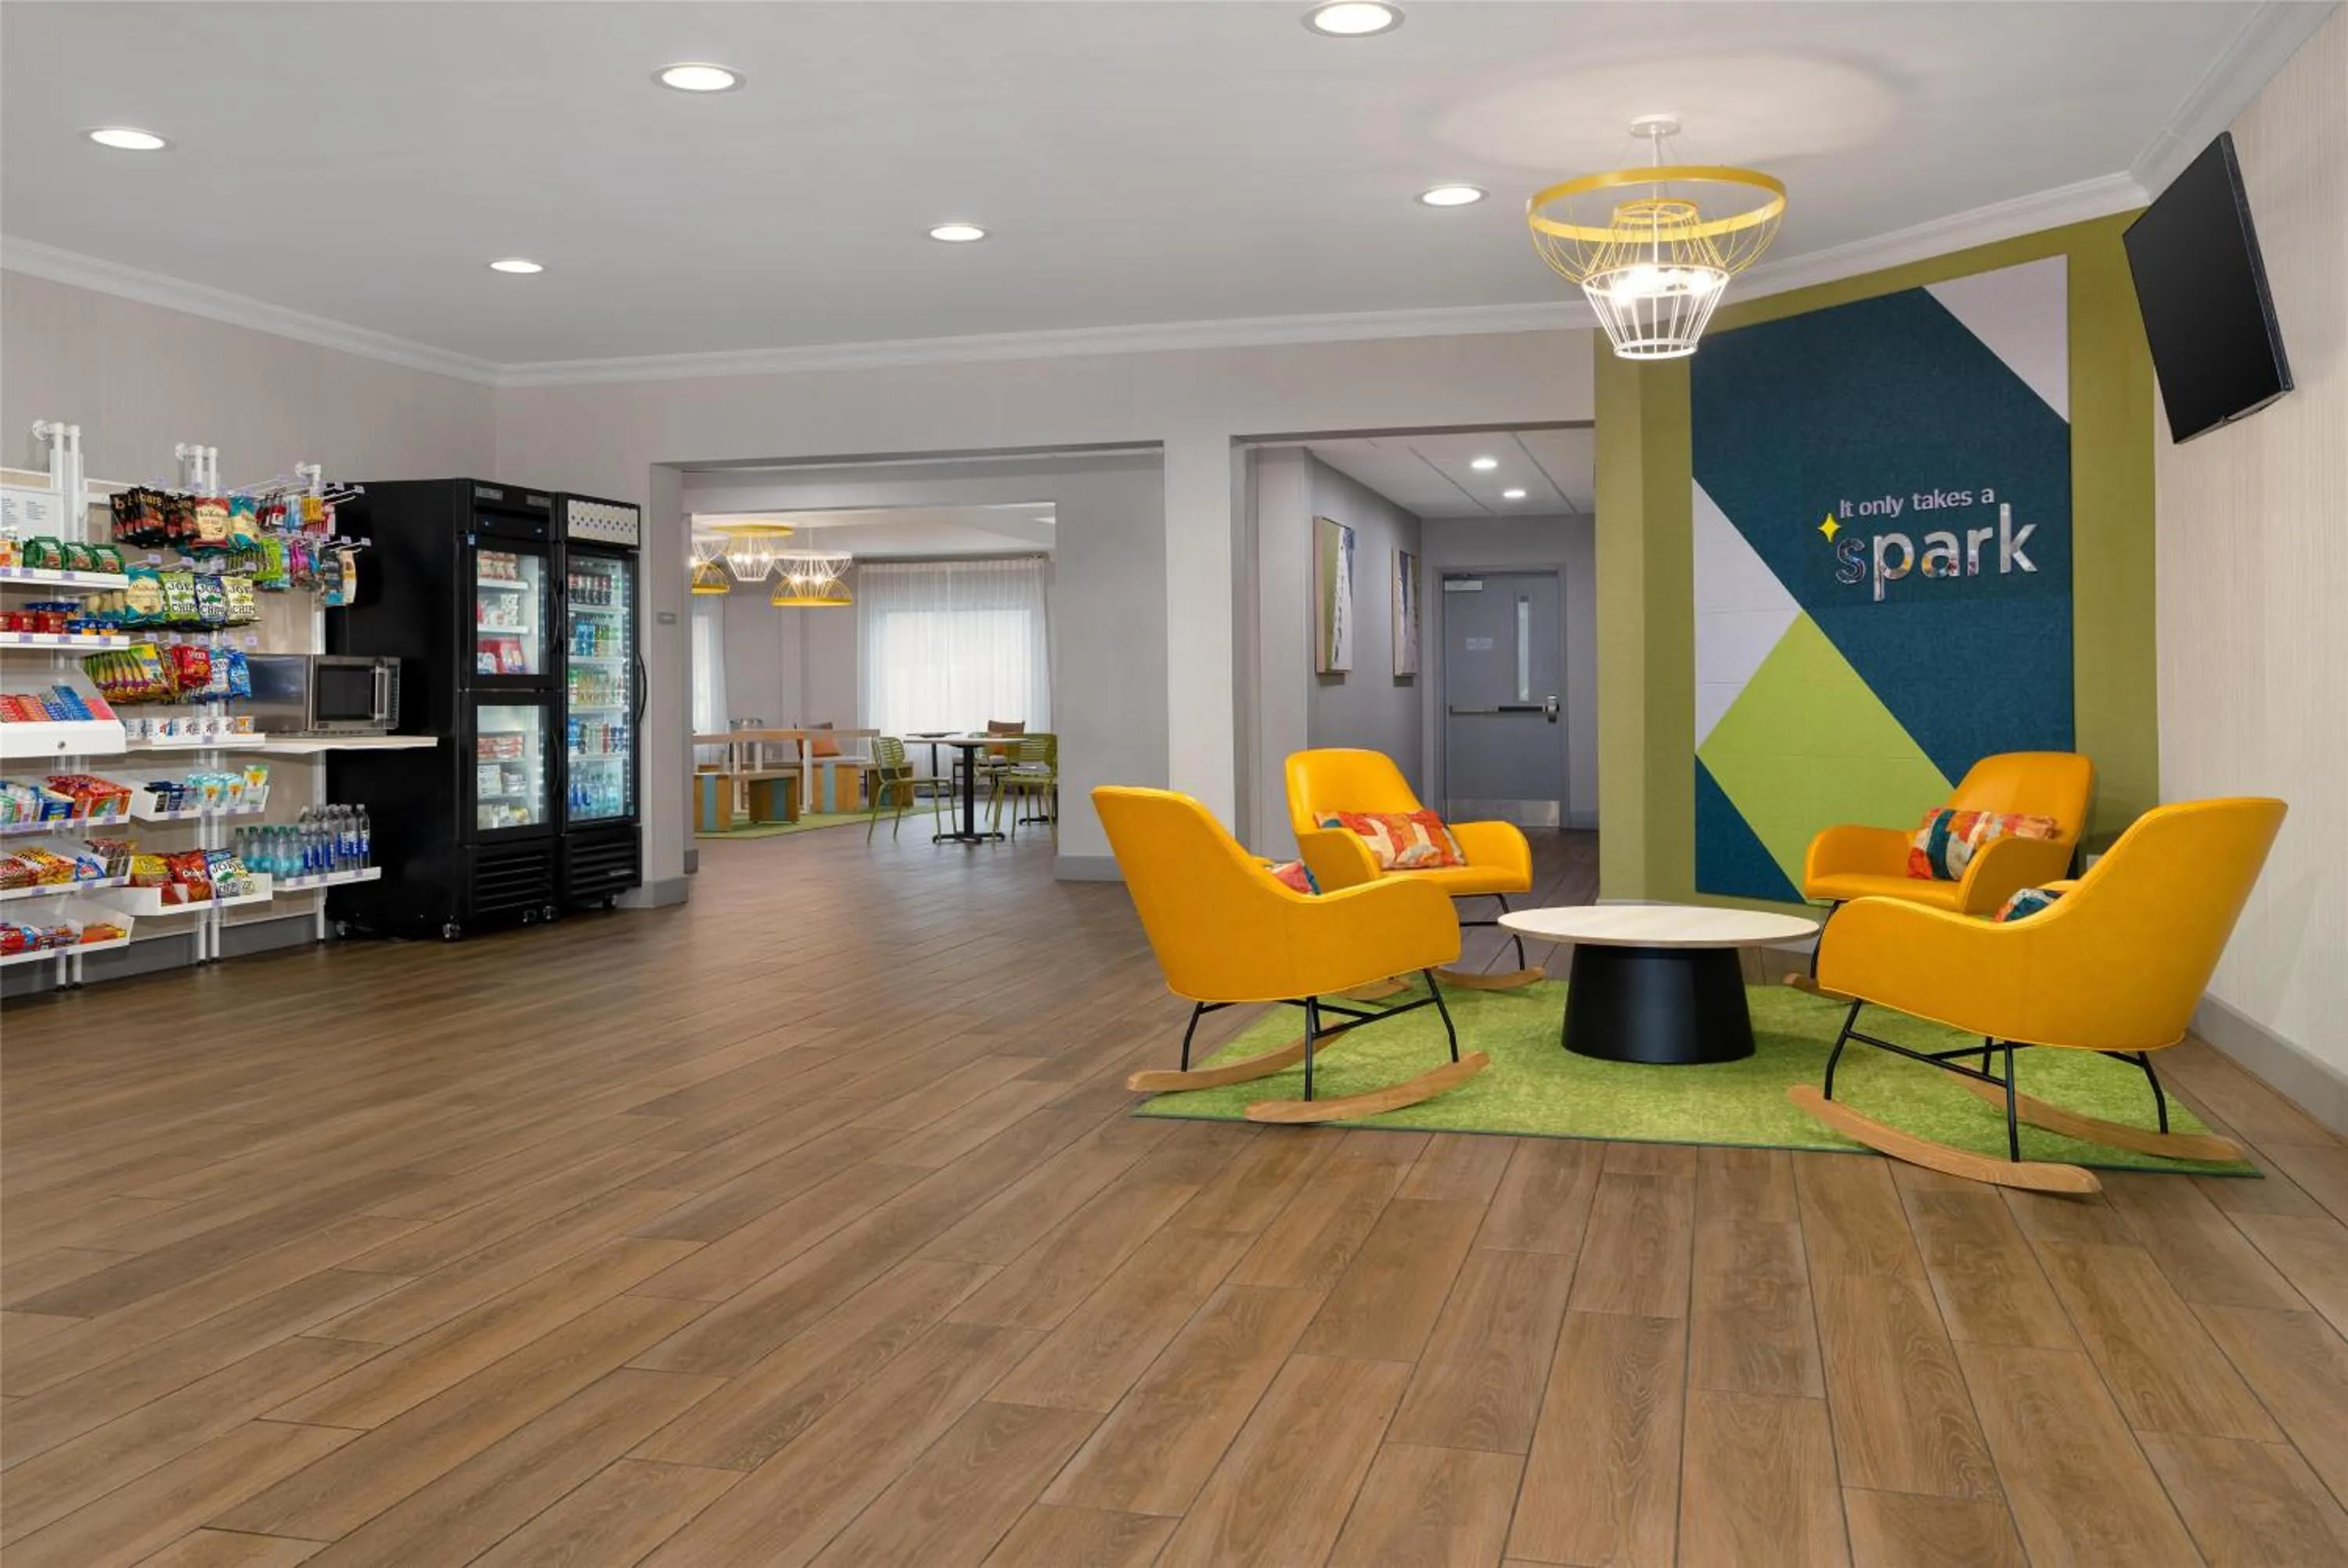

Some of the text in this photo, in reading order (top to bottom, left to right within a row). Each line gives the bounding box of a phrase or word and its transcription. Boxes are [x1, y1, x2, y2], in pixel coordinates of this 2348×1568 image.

[1839, 487, 1995, 519] It only takes a
[1835, 502, 2038, 602] spark
